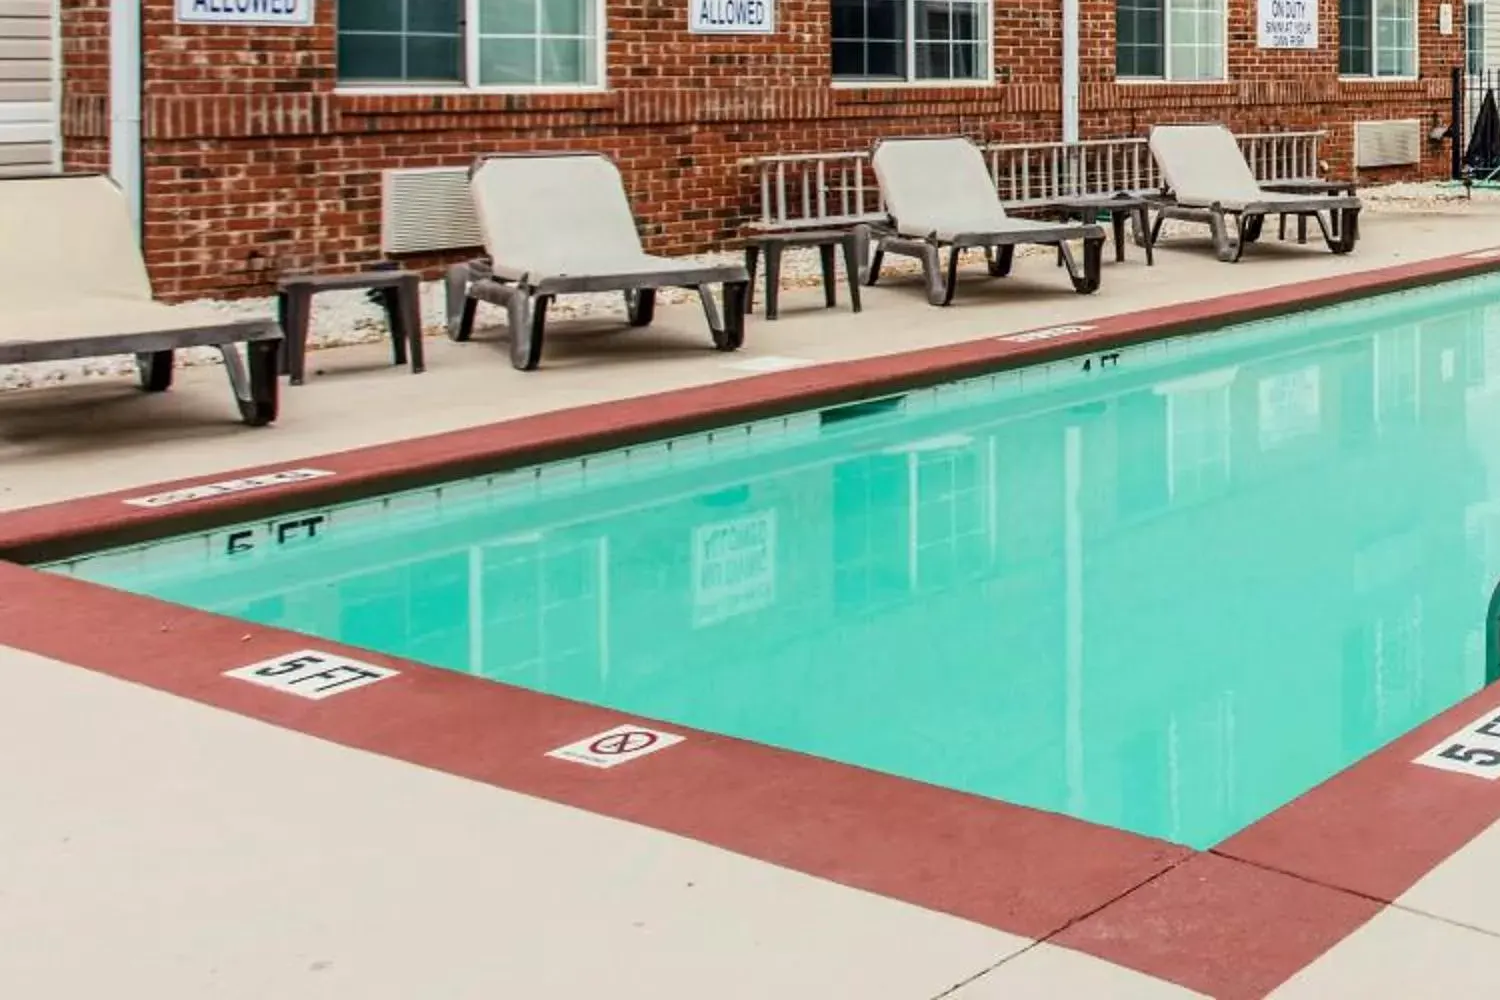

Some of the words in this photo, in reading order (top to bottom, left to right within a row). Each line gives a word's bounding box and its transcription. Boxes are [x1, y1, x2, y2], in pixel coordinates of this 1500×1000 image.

[700, 0, 764, 25] ALLOWED
[1272, 0, 1284, 18] ON
[1286, 1, 1305, 19] DUTY
[278, 516, 324, 544] FT
[256, 656, 325, 677] 5
[288, 665, 382, 693] FT
